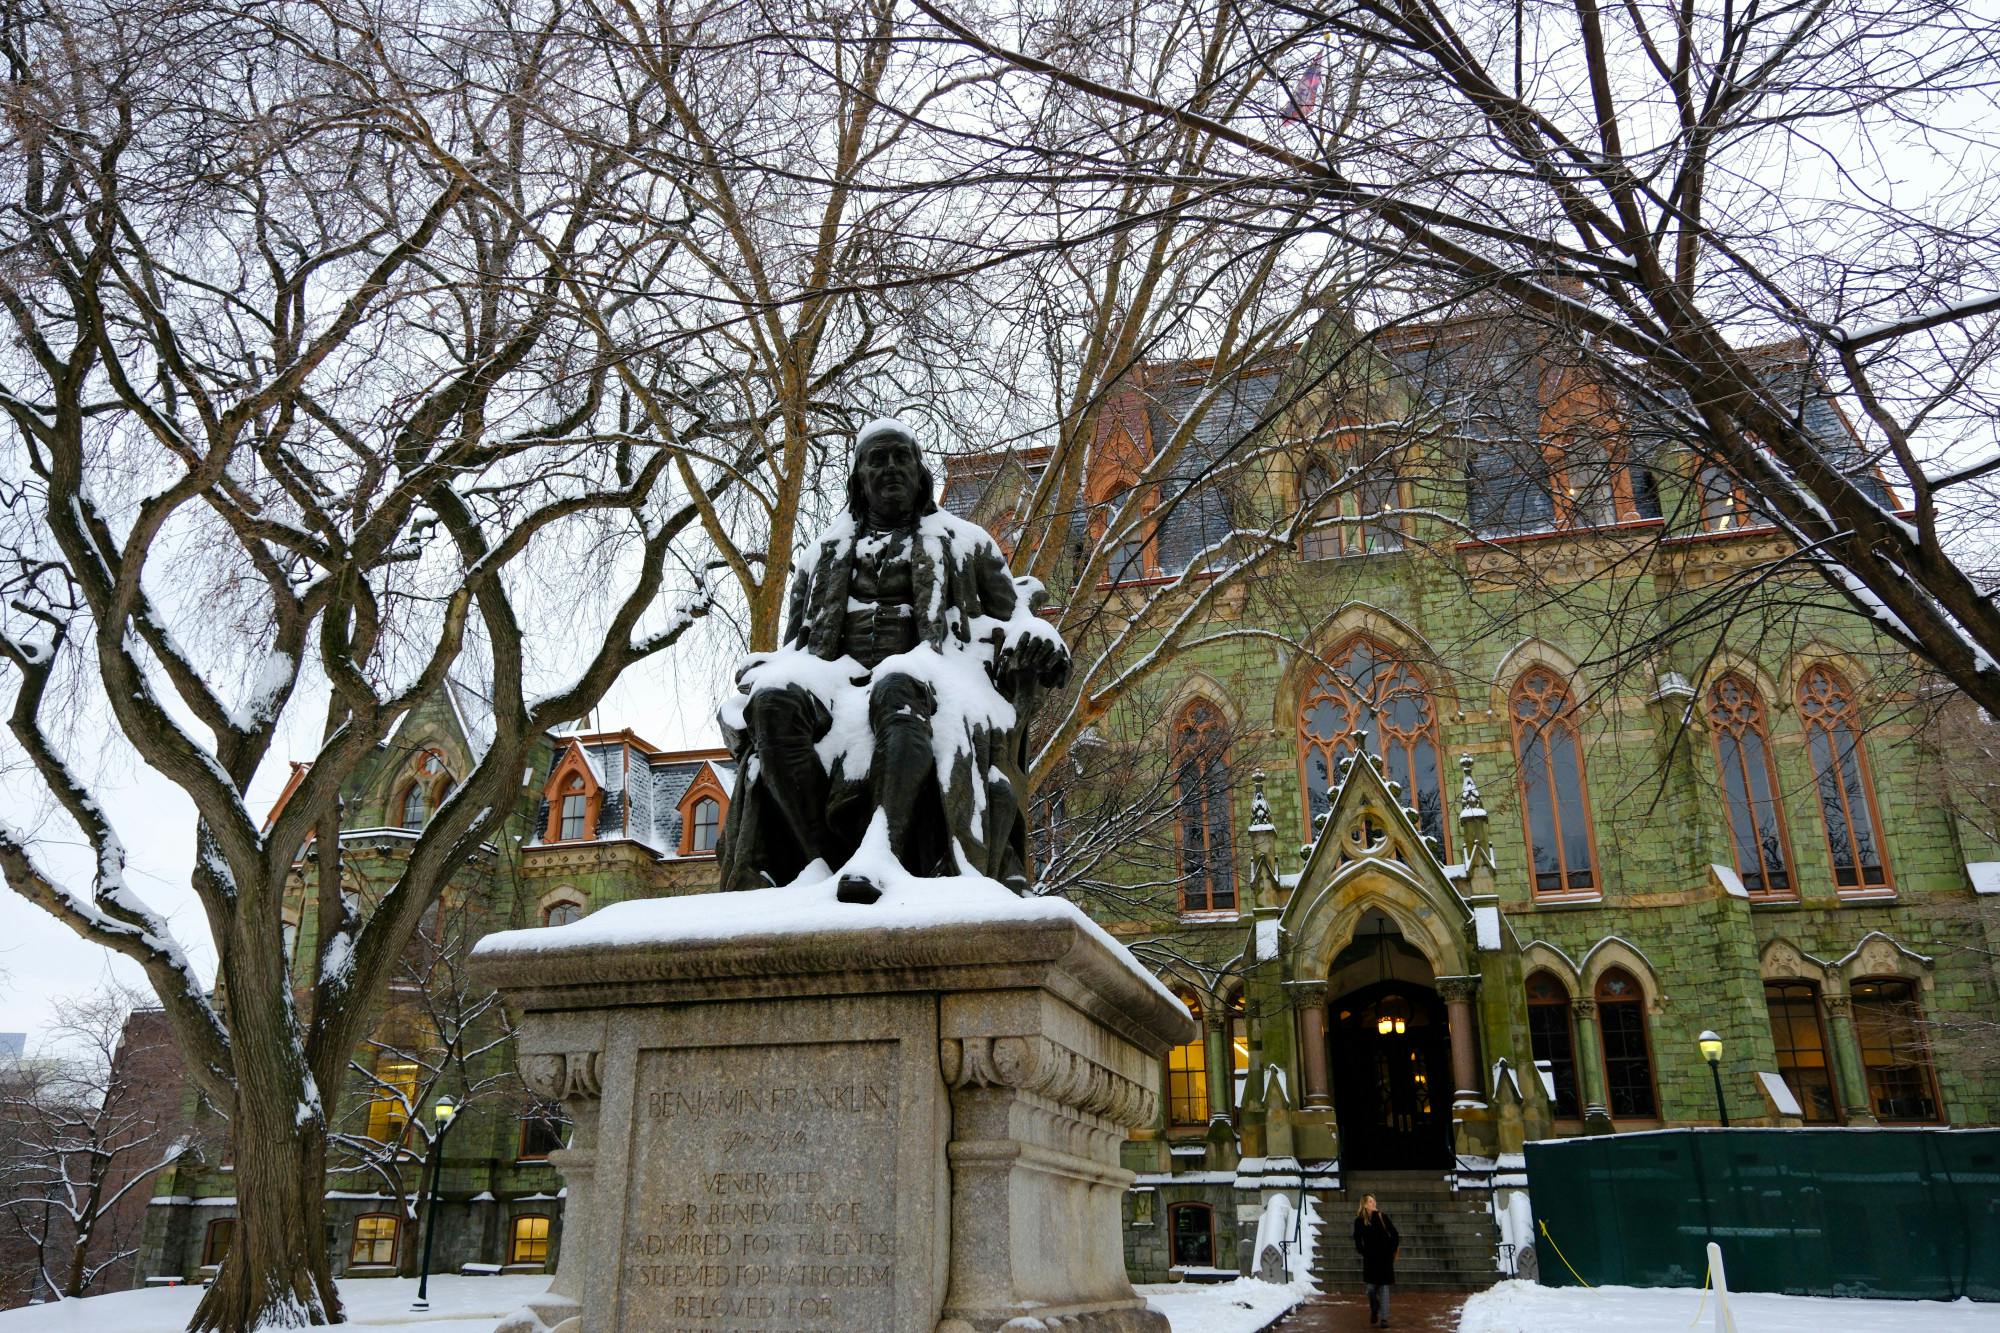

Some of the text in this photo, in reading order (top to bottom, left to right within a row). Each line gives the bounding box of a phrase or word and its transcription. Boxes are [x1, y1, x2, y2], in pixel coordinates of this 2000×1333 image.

[649, 1085, 888, 1122] BENJAMIN FRANKLIN
[660, 1202, 862, 1225] FOR BENEVOLENCE
[633, 1233, 889, 1256] ADMIRED FOR TALENTS
[736, 1265, 774, 1287] FOR
[778, 1265, 889, 1288] PATRIOTISM
[674, 1296, 834, 1320] BELOVED FOR
